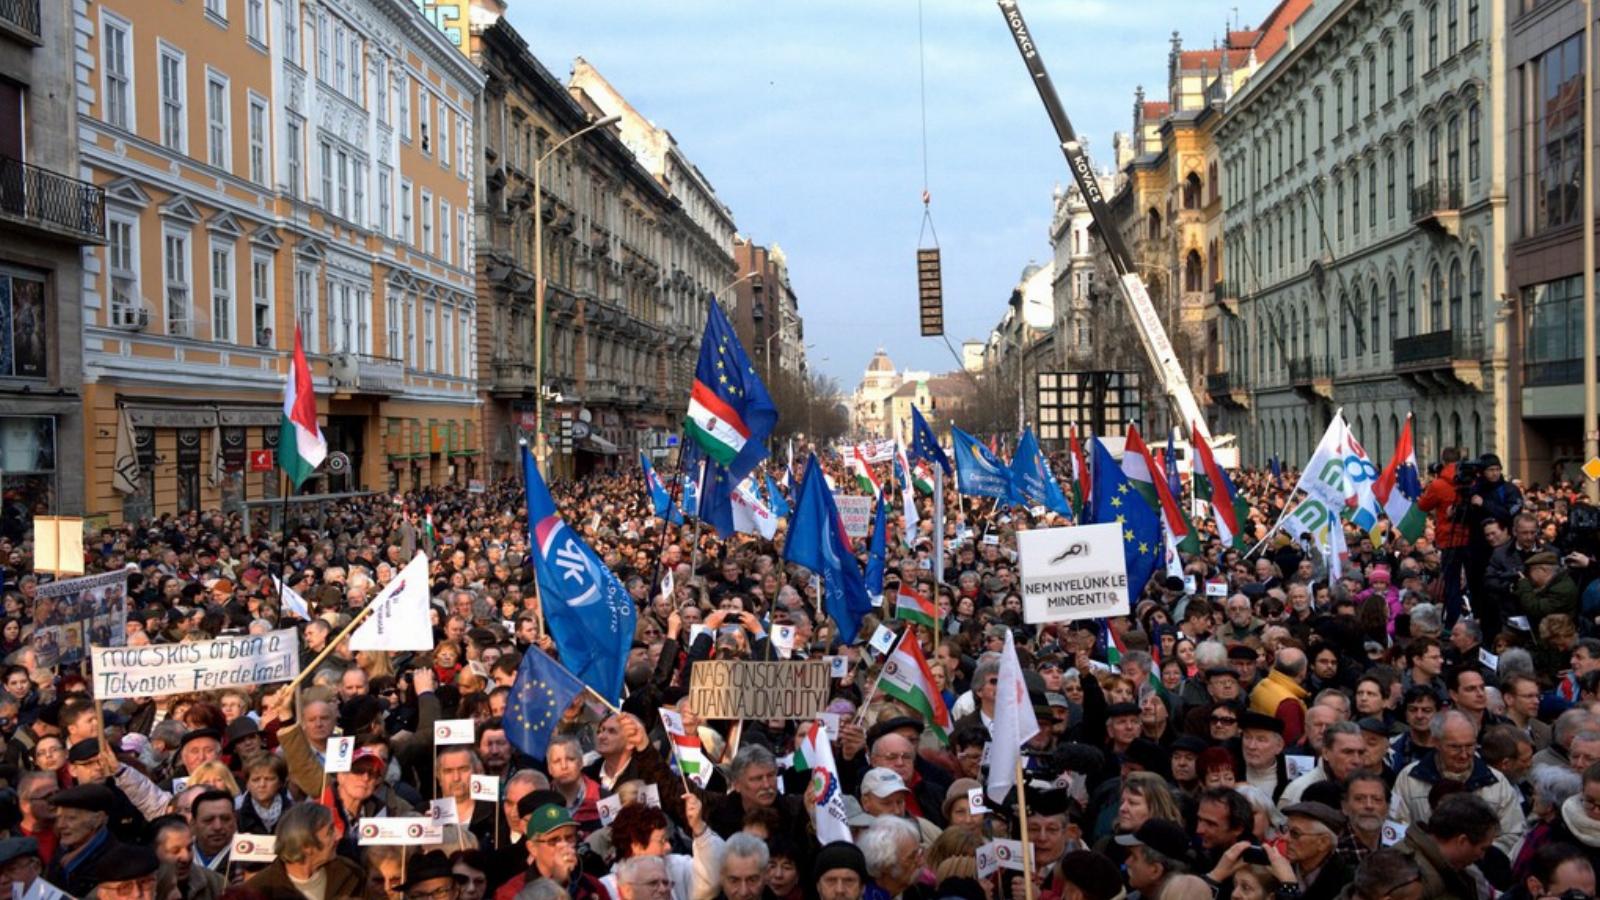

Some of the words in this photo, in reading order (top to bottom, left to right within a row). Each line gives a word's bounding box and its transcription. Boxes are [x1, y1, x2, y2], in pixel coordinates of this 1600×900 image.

[1025, 582, 1052, 595] NEM
[1054, 576, 1110, 592] NYELÜNK
[1111, 575, 1127, 587] LE
[1048, 592, 1106, 608] MINDENT!
